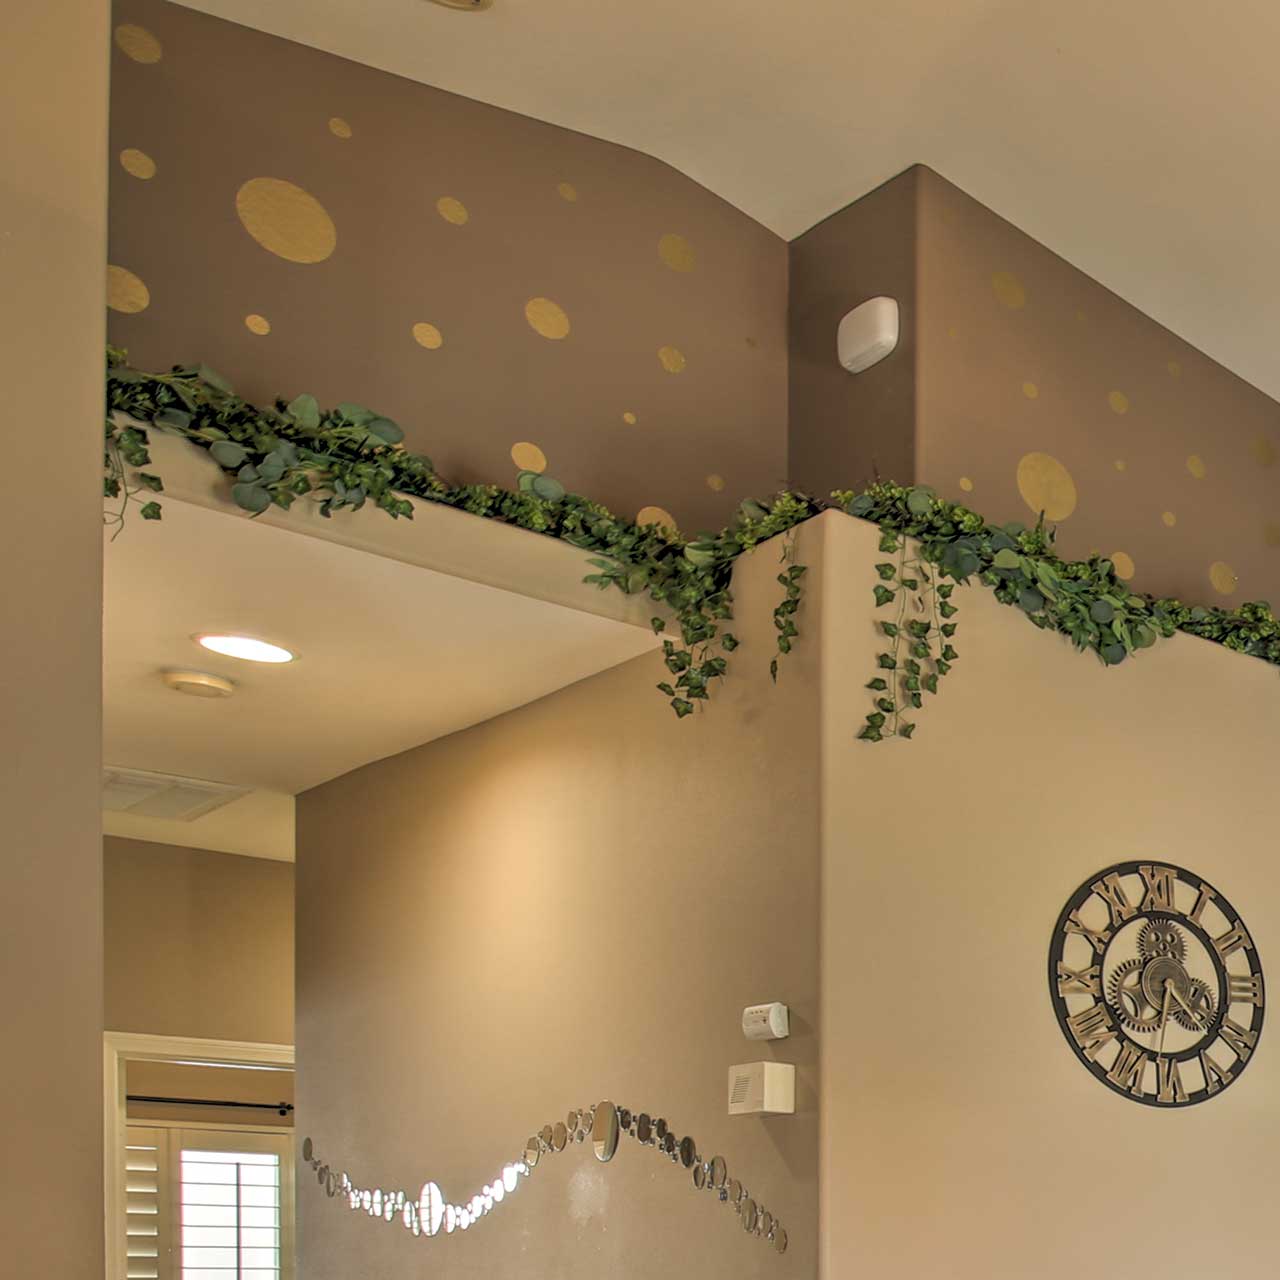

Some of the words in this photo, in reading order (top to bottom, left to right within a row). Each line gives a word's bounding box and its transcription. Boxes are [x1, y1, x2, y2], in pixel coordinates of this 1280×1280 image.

[1091, 873, 1138, 926] XI
[1138, 865, 1177, 914] XII
[1187, 883, 1217, 928] I
[1064, 909, 1111, 954] X
[1212, 922, 1252, 964] II
[1058, 961, 1101, 997] IX
[1225, 973, 1263, 1007] III
[1067, 1003, 1118, 1062] VIII
[1218, 1013, 1258, 1063] IV
[1106, 1039, 1148, 1097] VII
[1156, 1056, 1190, 1102] VI
[1200, 1049, 1233, 1095] V
